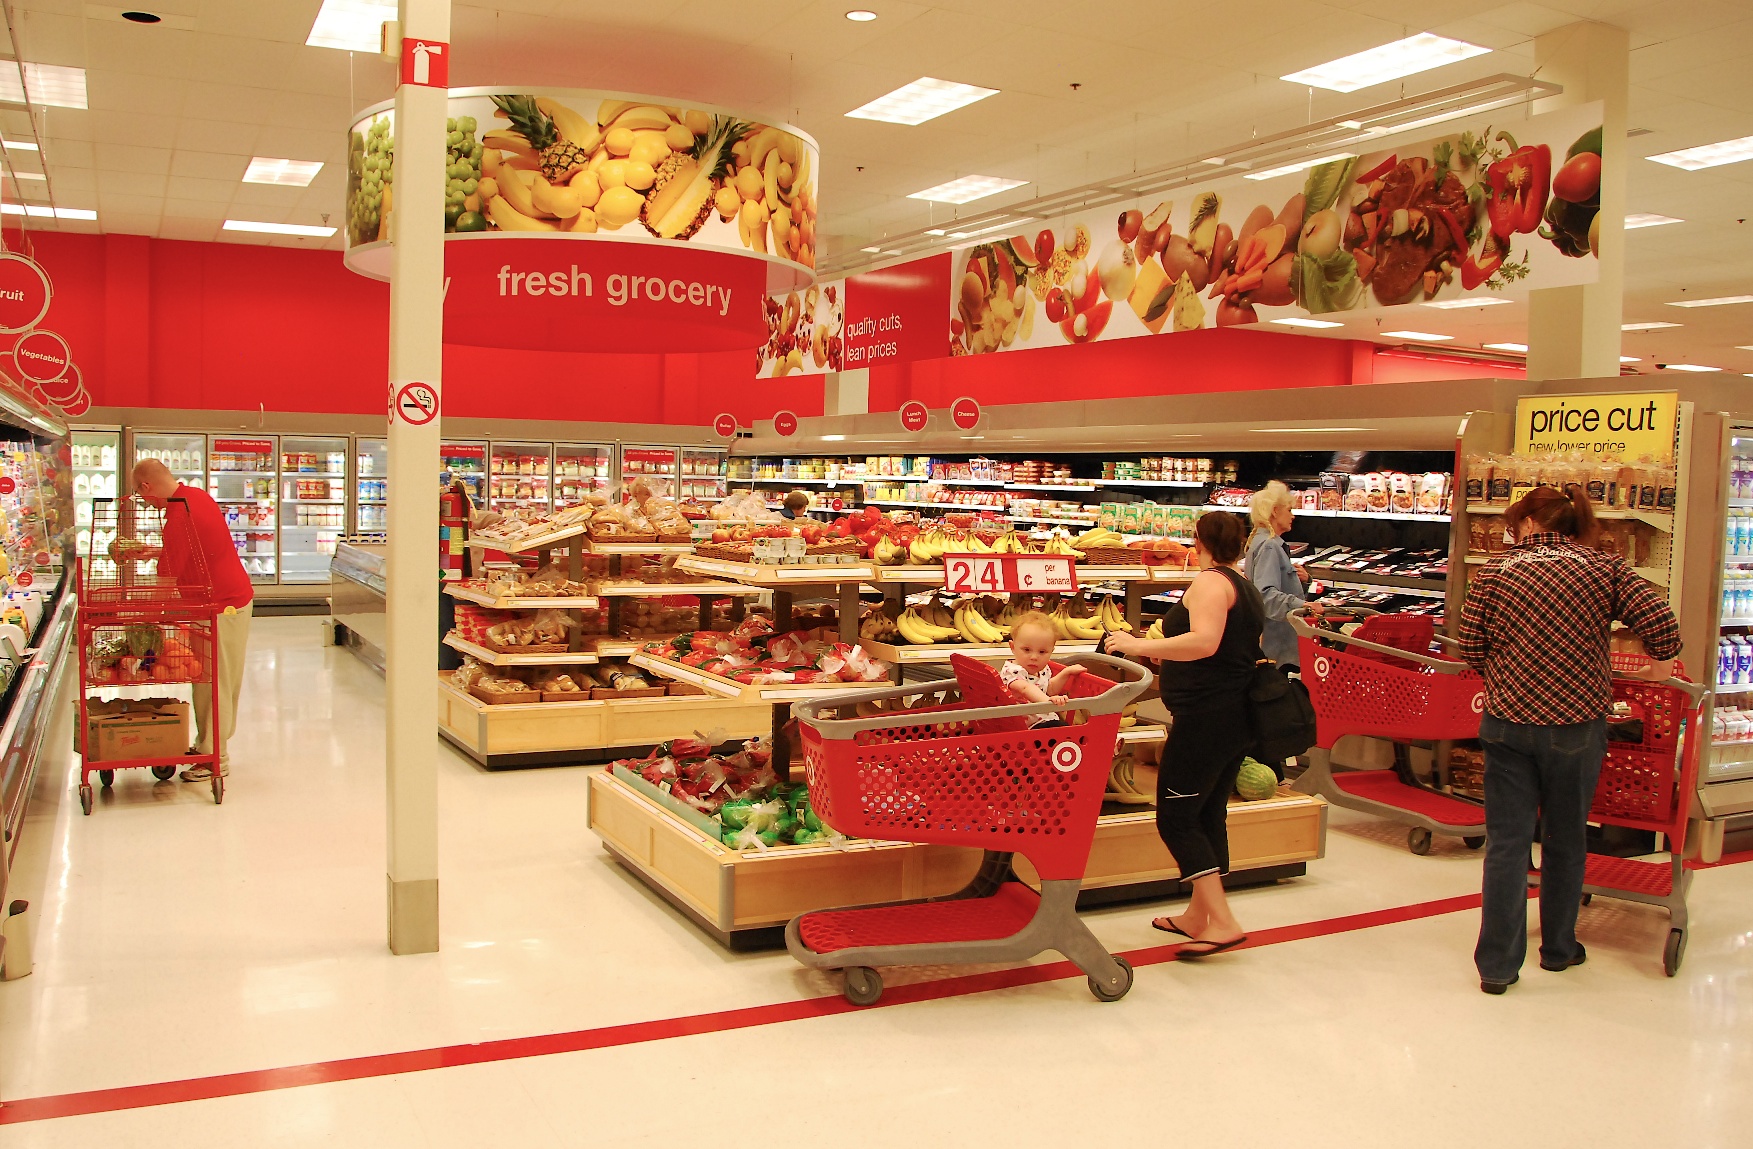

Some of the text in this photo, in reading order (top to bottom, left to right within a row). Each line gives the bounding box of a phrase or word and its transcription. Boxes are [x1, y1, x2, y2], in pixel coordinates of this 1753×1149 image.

[0, 287, 24, 302] ruit
[497, 265, 732, 316] fresh grocery
[847, 312, 903, 341] quality cuts,
[20, 348, 65, 365] Vegetables
[846, 339, 898, 364] lean prices
[1529, 400, 1657, 440] price cut
[1593, 439, 1626, 454] price
[1044, 564, 1056, 573] per
[1045, 576, 1071, 586] banana
